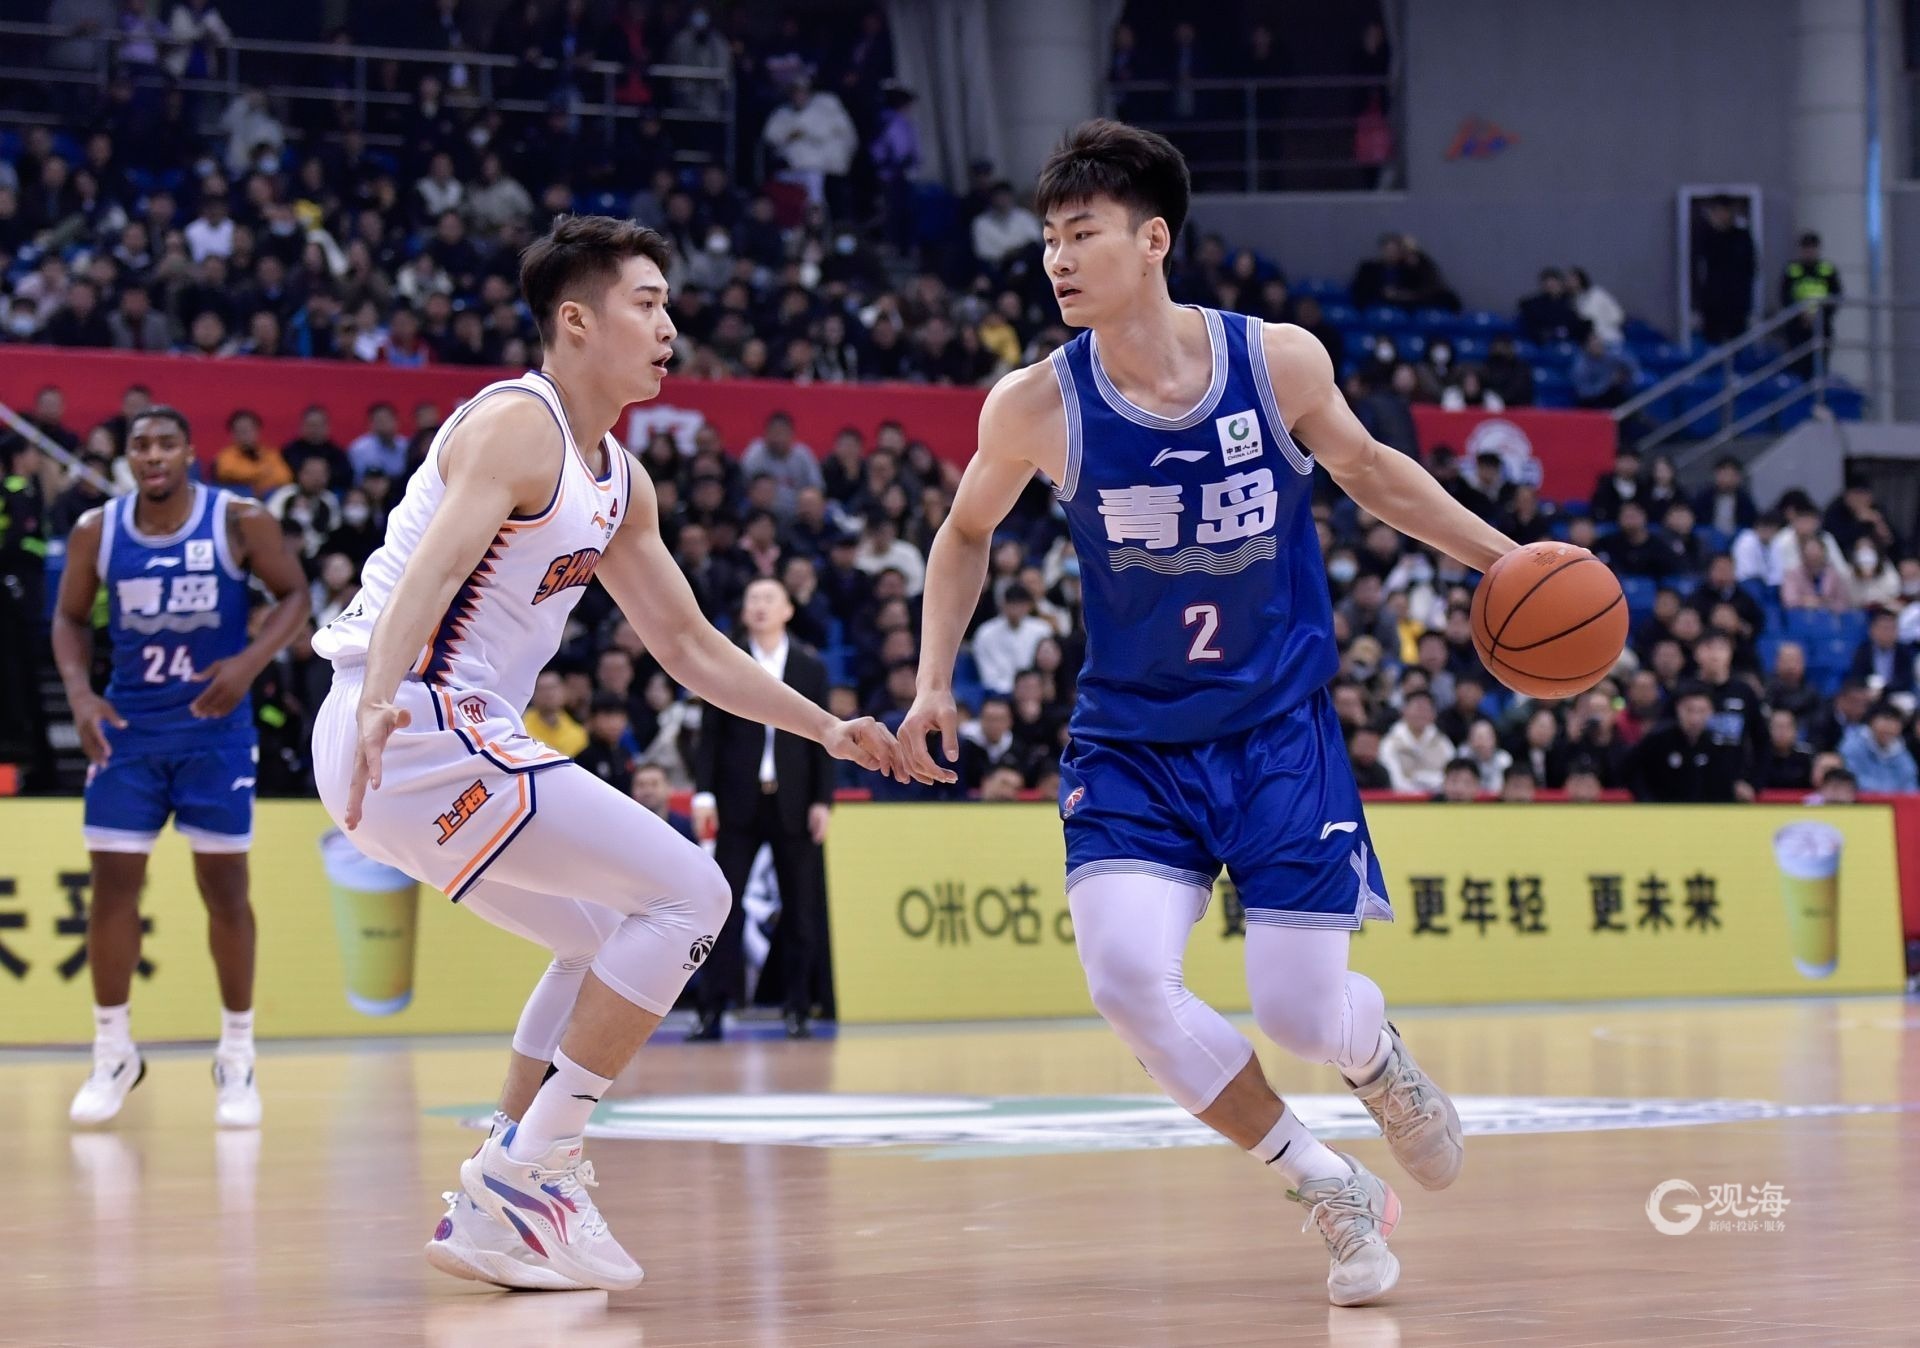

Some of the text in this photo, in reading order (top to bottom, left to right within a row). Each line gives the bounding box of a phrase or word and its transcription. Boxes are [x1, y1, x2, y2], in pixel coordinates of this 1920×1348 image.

[1097, 467, 1278, 550] 青岛
[117, 574, 219, 617] 青岛
[1183, 603, 1223, 662] 2
[141, 645, 195, 684] 24
[433, 779, 494, 845] 上海
[1408, 869, 1722, 936] 更年轻 更未来
